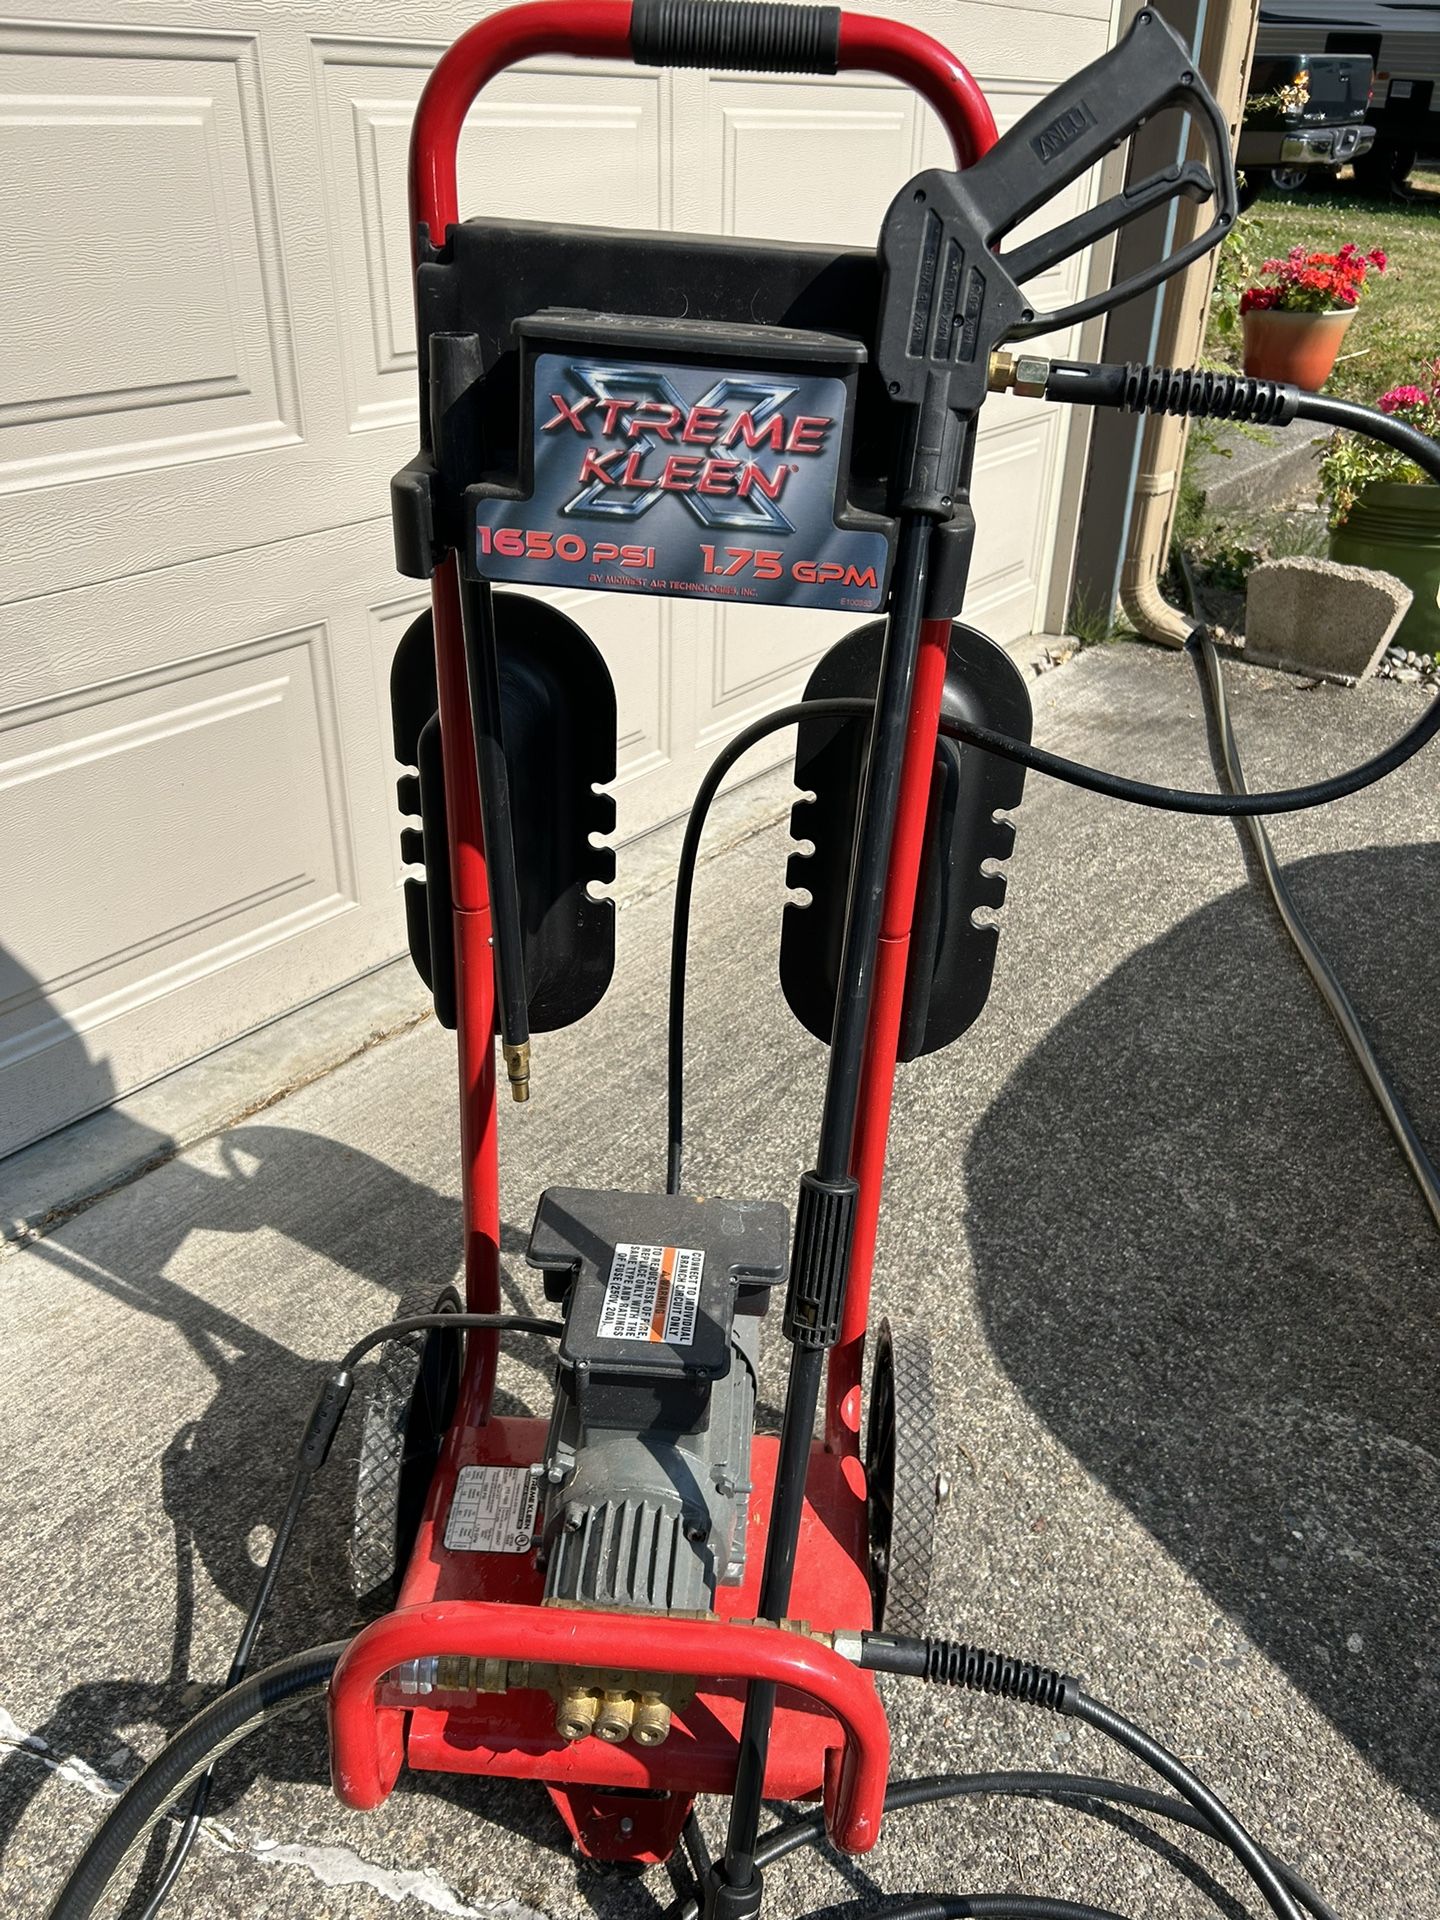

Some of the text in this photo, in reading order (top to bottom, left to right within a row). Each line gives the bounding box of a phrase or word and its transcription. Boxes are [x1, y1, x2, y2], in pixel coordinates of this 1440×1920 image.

[540, 393, 832, 452] XTREME
[578, 447, 790, 498] KLEEN
[477, 525, 879, 589] 1650 PSI 1.75 GPM
[588, 574, 602, 583] BY
[604, 575, 647, 587] MIDWEST
[650, 579, 667, 590] AIR
[617, 1252, 628, 1262] OF
[652, 1247, 662, 1256] TO
[612, 1263, 625, 1282] FUSE
[646, 1257, 660, 1287] REDUCE
[613, 1246, 640, 1337] SAME TYPE AND RATINGS
[625, 1247, 651, 1337] REPLACE ONLY WITH THE
[643, 1288, 655, 1305] RISK
[655, 1279, 671, 1315] WARNING
[668, 1255, 690, 1337] BRANCH CIRCUIT ONLY
[679, 1252, 702, 1342] CONNECT TO INDIVIDUAL
[641, 1306, 652, 1315] OF
[523, 1504, 534, 1530] KLEEN
